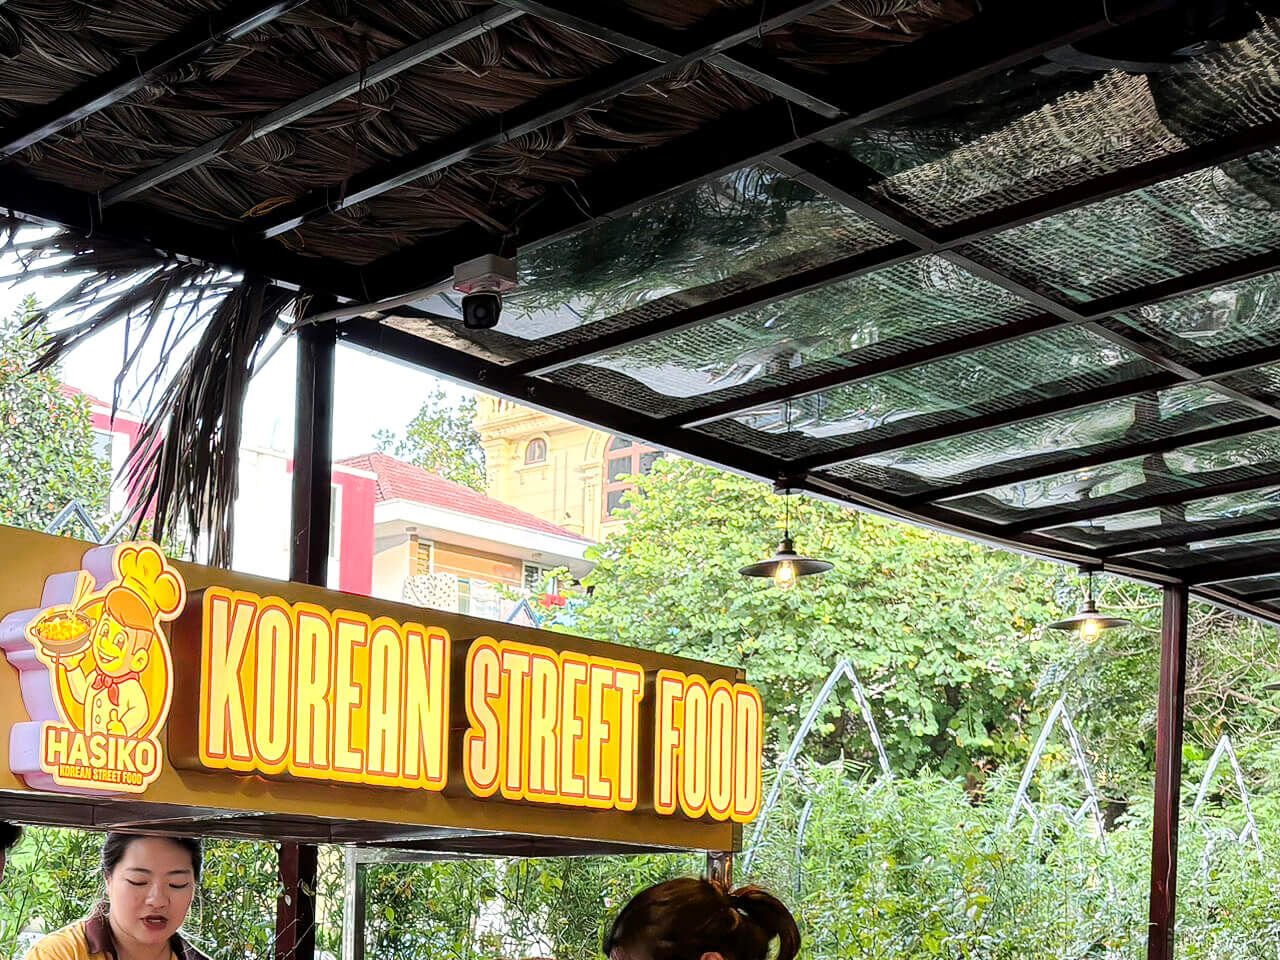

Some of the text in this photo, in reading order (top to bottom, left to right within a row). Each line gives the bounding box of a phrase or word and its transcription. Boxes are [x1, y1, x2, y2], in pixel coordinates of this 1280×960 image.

[206, 596, 760, 816] KOREAN STREET FOOD
[47, 729, 157, 774] HASIKO
[60, 765, 143, 785] KOREAN STREET FOOD
